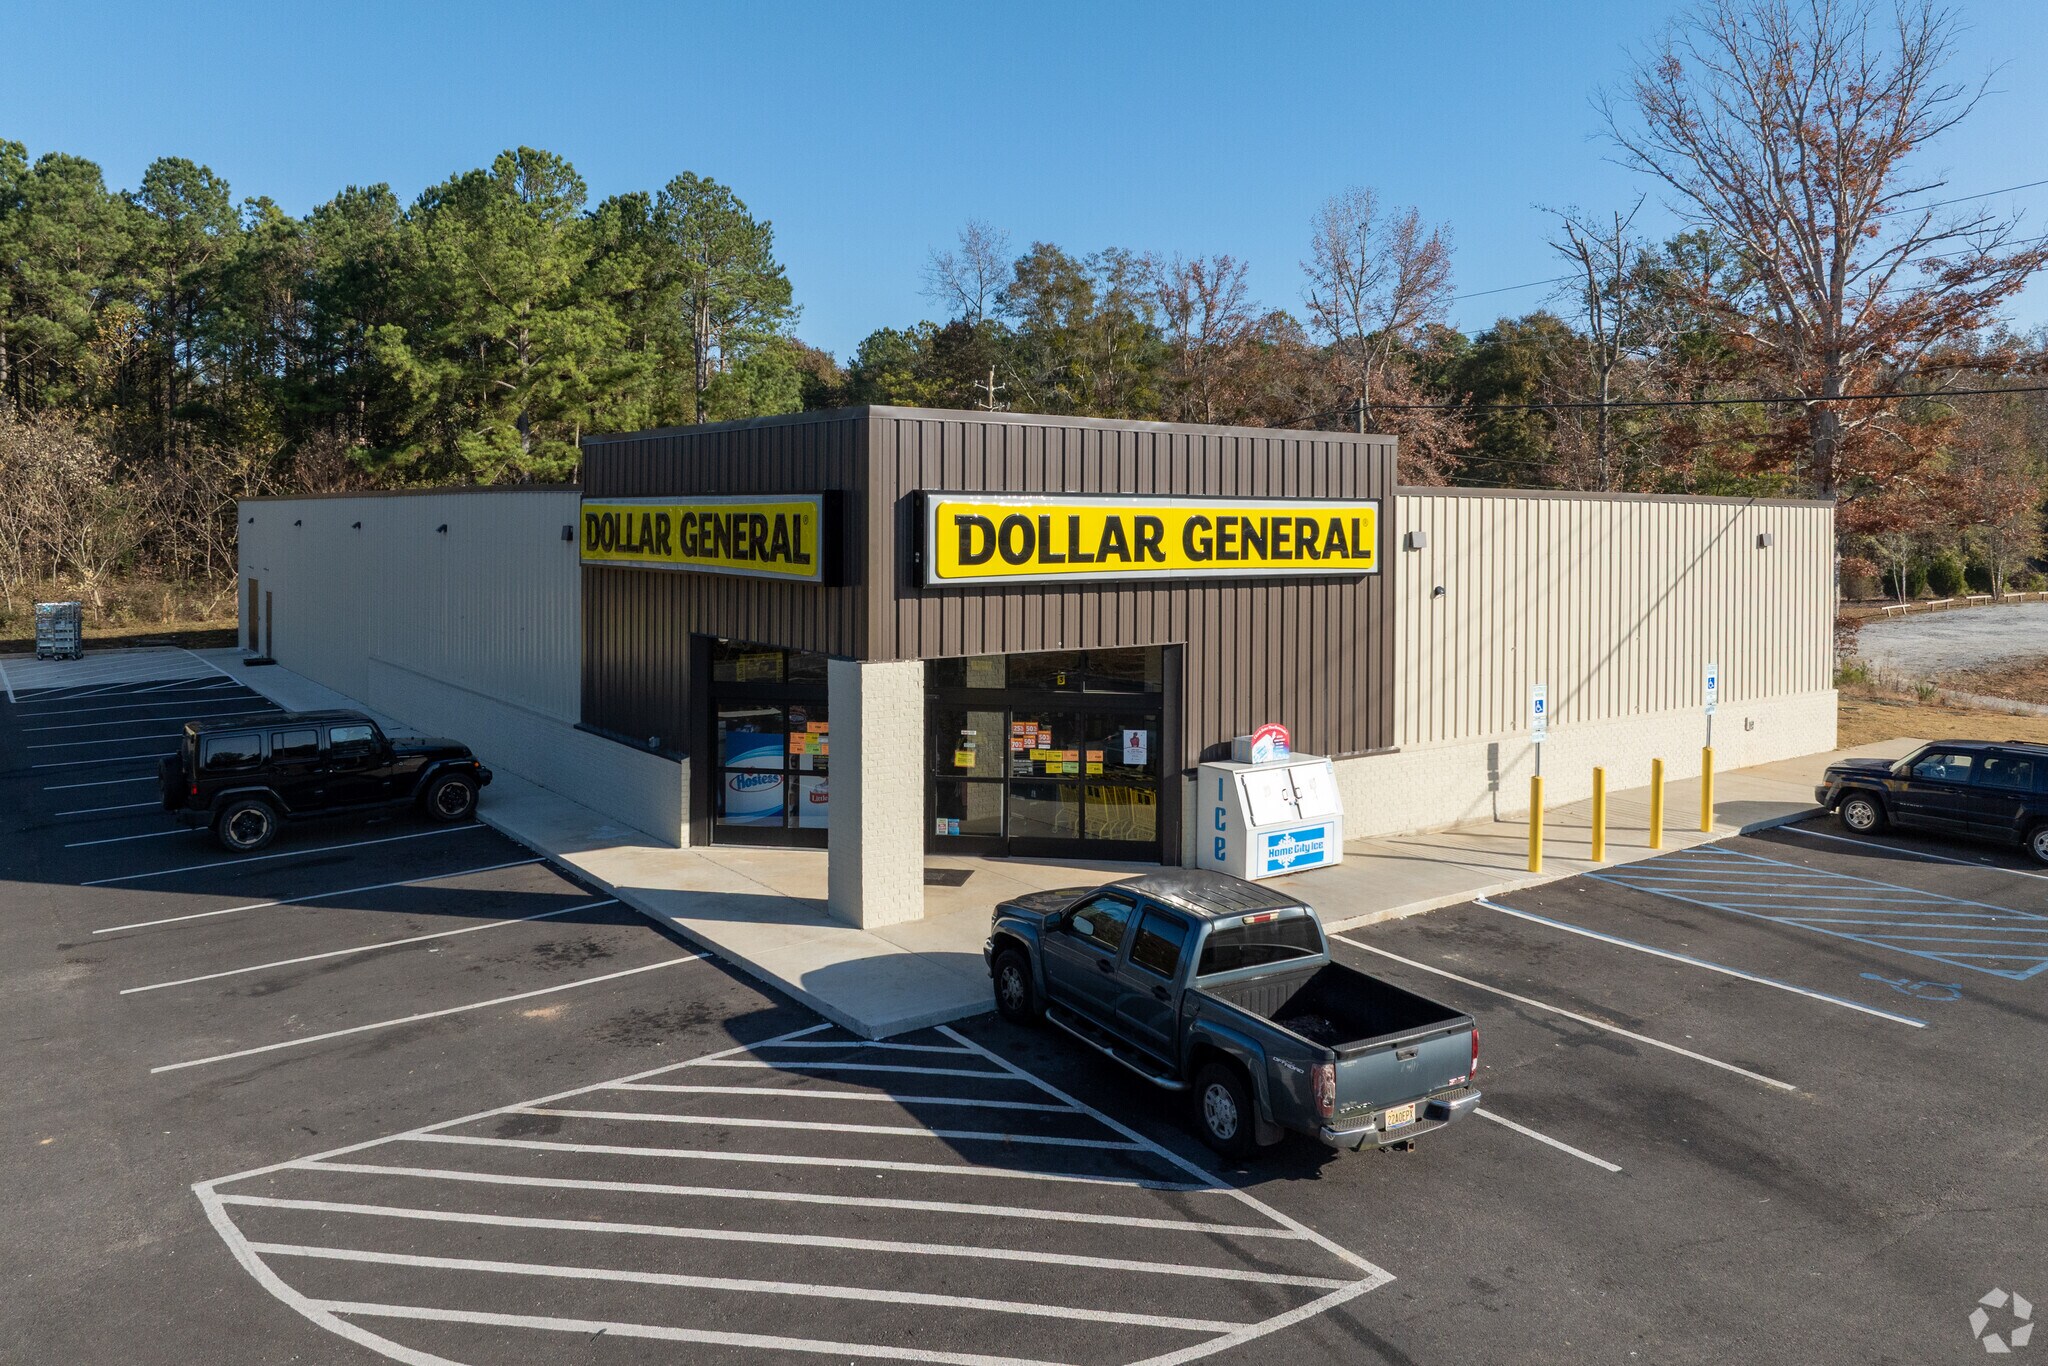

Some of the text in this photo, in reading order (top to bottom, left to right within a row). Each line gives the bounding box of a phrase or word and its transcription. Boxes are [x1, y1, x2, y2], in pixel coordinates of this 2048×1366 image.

[585, 511, 810, 565] DOLLAR GENERAL
[954, 513, 1371, 566] DOLLAR GENERAL
[736, 773, 779, 790] Hostess
[1268, 841, 1324, 858] Home City Ice
